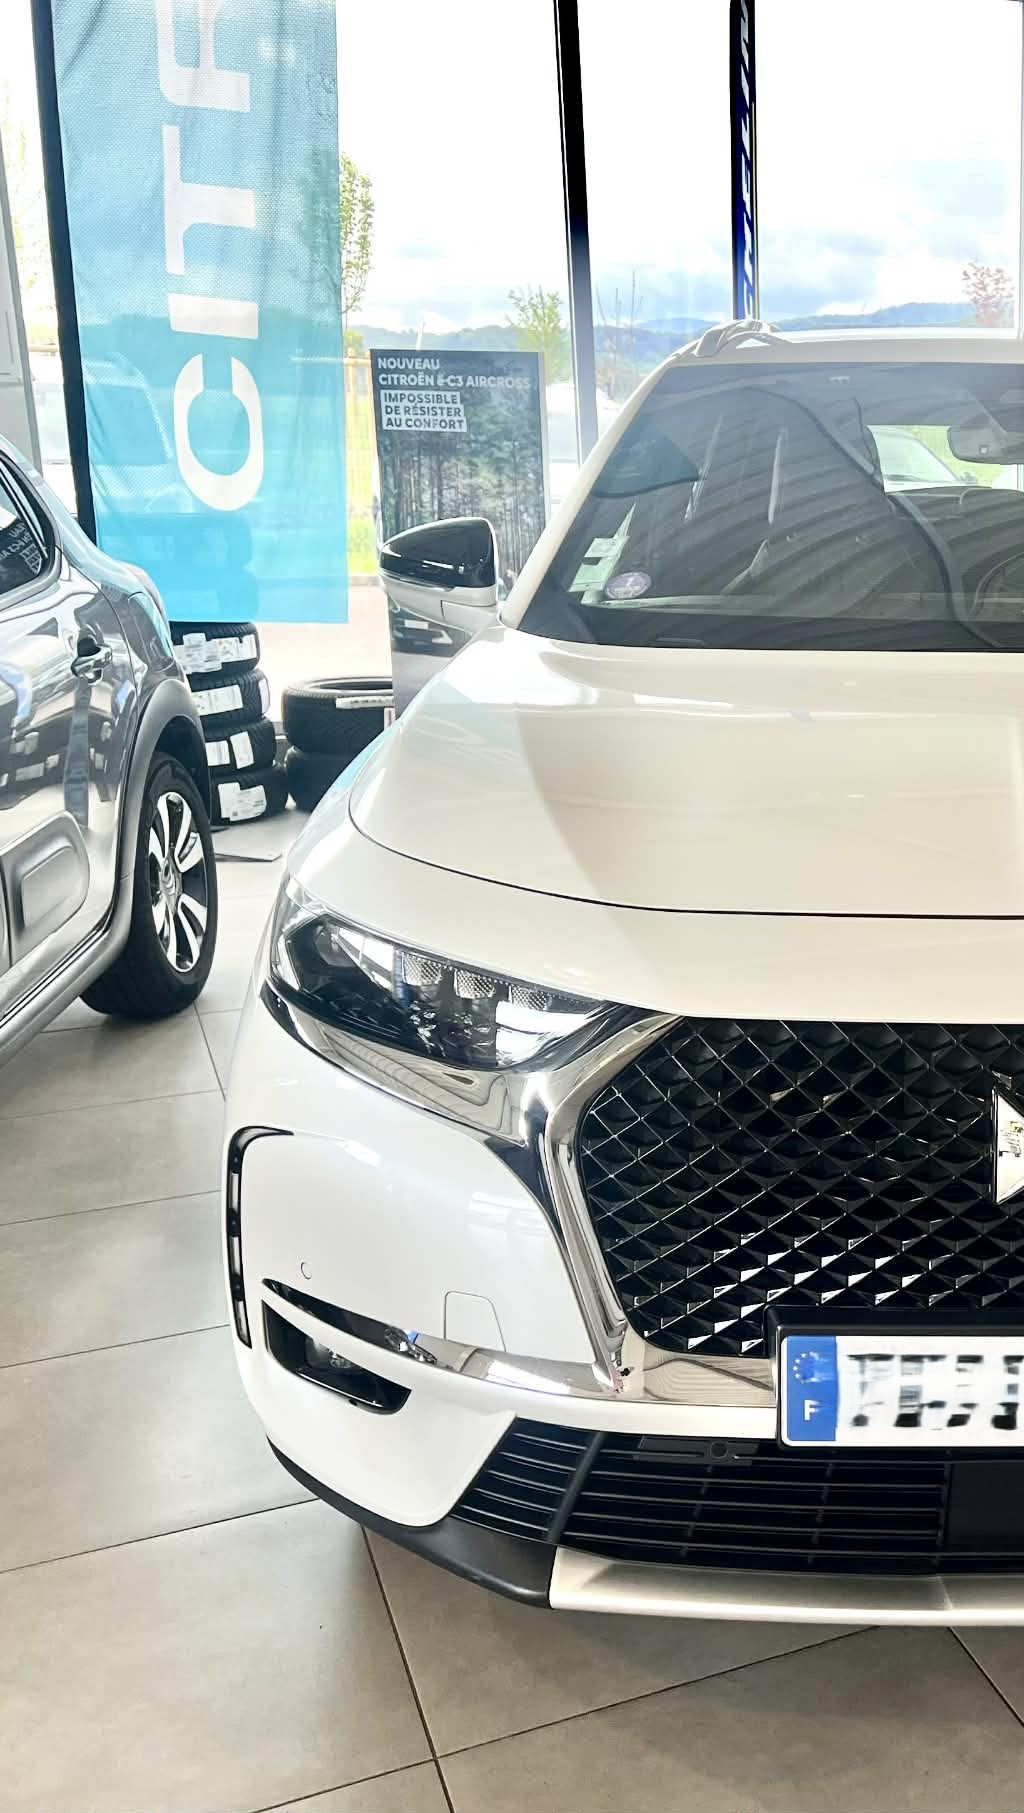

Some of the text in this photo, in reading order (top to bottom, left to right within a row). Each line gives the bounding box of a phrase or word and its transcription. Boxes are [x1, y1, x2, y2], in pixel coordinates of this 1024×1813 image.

[377, 357, 441, 370] NOUVEAU
[378, 371, 435, 387] CITROËN
[465, 374, 531, 390] AIRCROSS
[384, 392, 460, 405] IMPOSSIBLE
[384, 401, 462, 418] DE RÉSISTER
[385, 417, 464, 430] AU CONFORT
[804, 1399, 820, 1421] F
